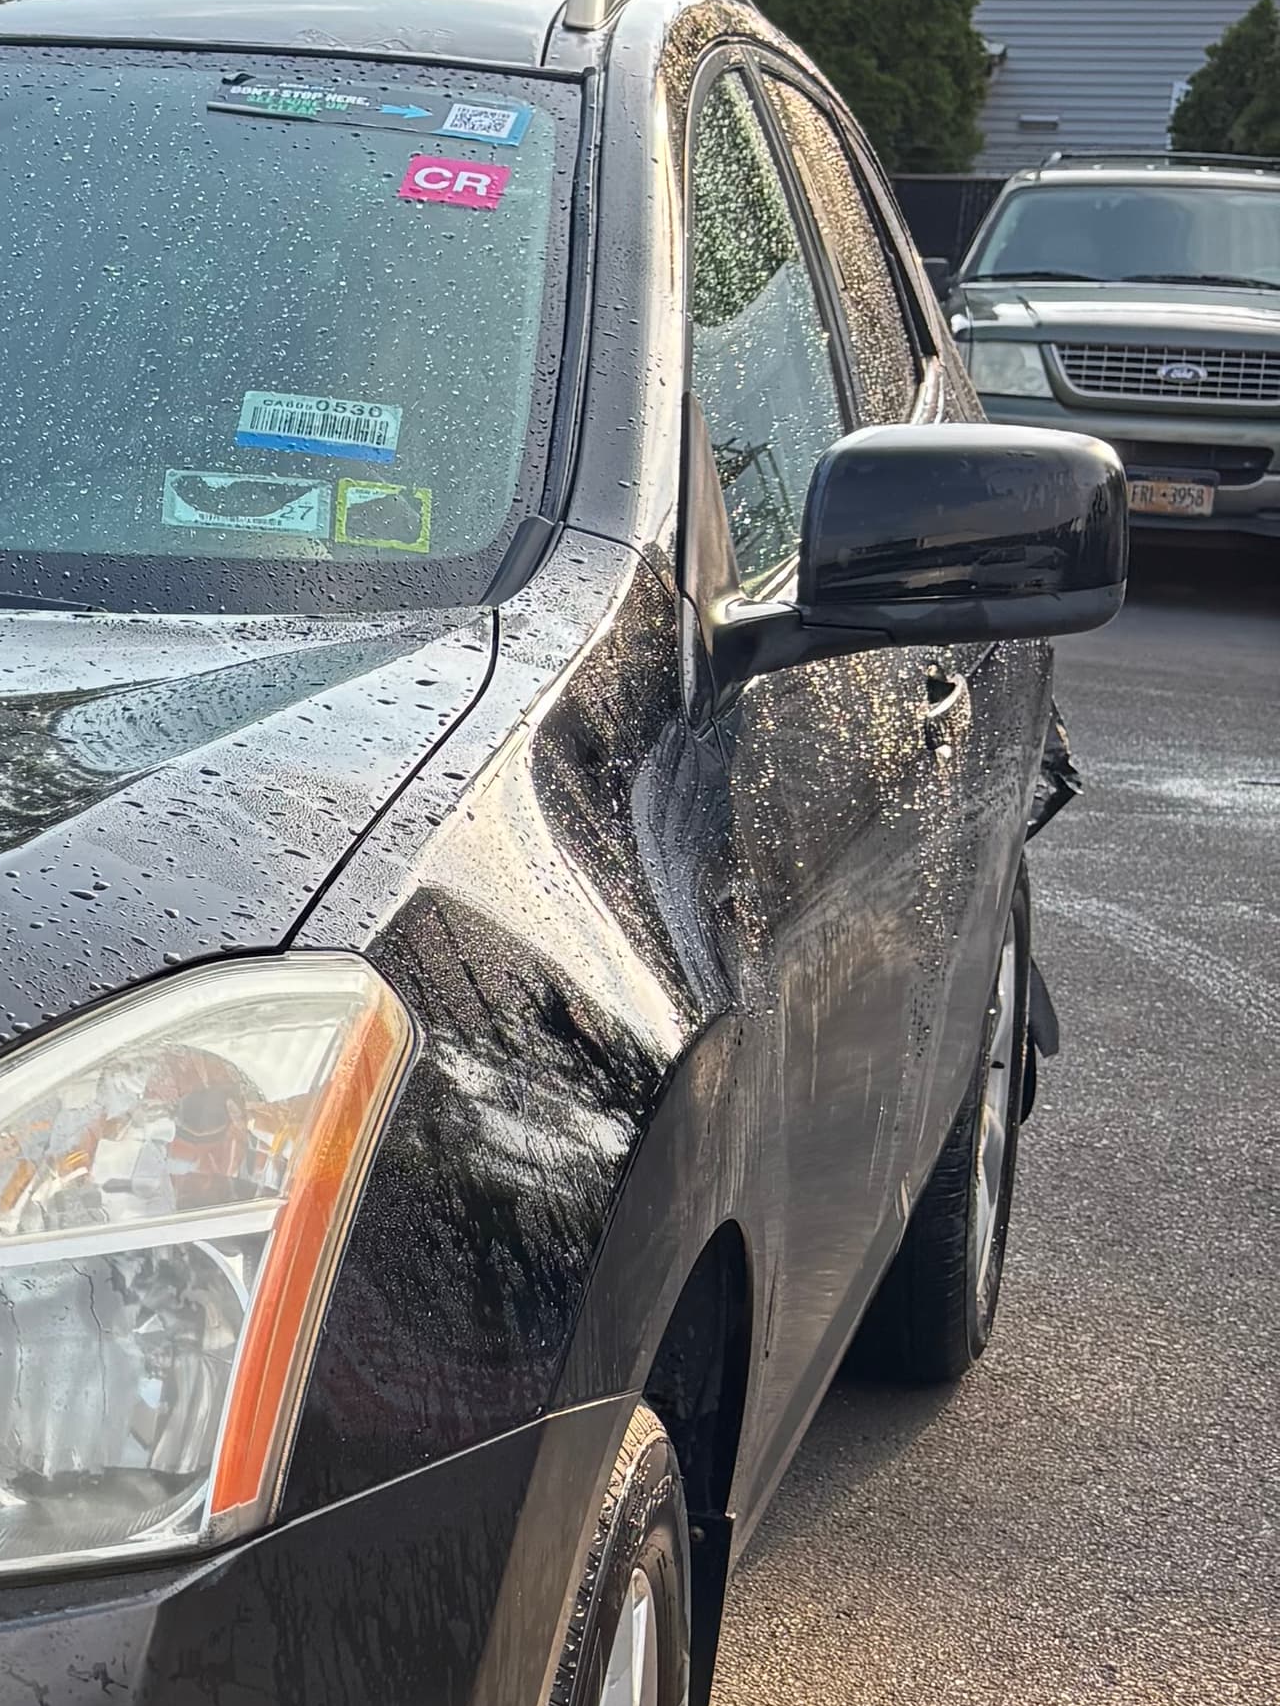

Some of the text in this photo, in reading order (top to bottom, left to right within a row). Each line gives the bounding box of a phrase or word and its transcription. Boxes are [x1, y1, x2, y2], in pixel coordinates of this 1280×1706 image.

[230, 85, 279, 97] DON'T
[281, 88, 323, 101] STOP
[413, 166, 492, 196] CR
